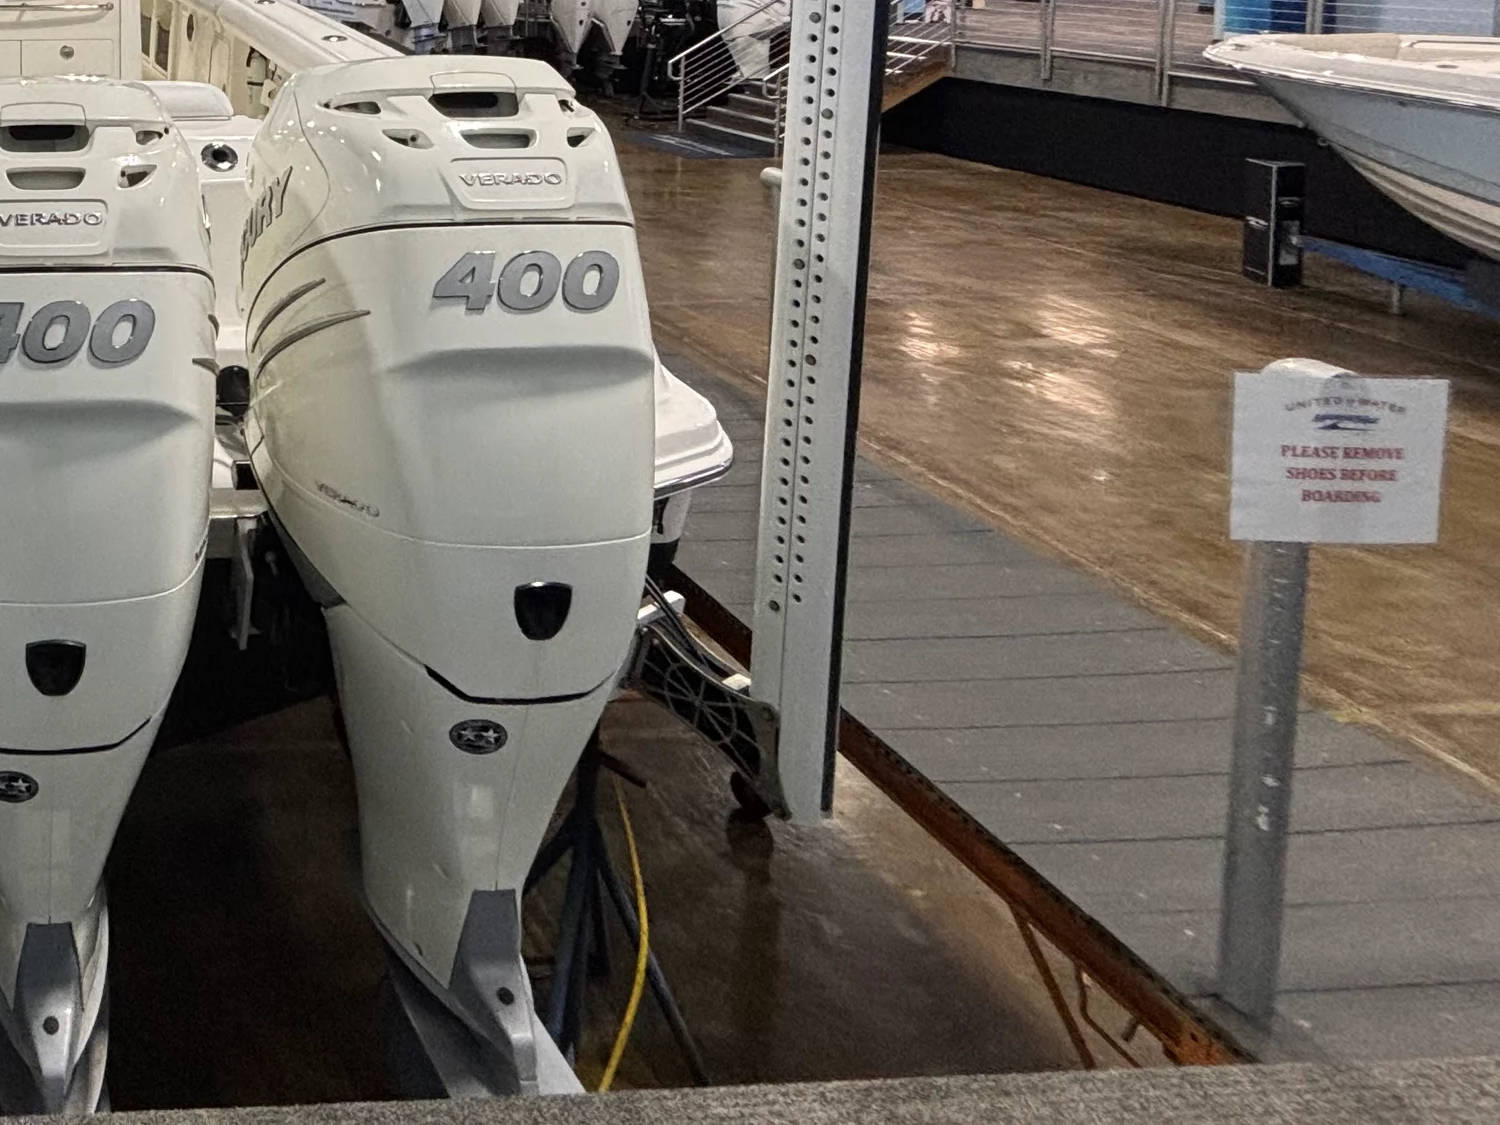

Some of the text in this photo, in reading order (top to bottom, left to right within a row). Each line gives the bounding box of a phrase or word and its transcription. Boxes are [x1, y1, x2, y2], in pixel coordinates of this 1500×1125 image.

[457, 171, 562, 188] VERADO
[431, 250, 621, 312] 400
[1285, 396, 1342, 412] UNITED
[1357, 397, 1407, 414] WATER
[1280, 444, 1406, 461] PLEASE REMOVE
[1286, 467, 1399, 482] SHOES BEFORE
[1301, 489, 1382, 504] BOARDING
